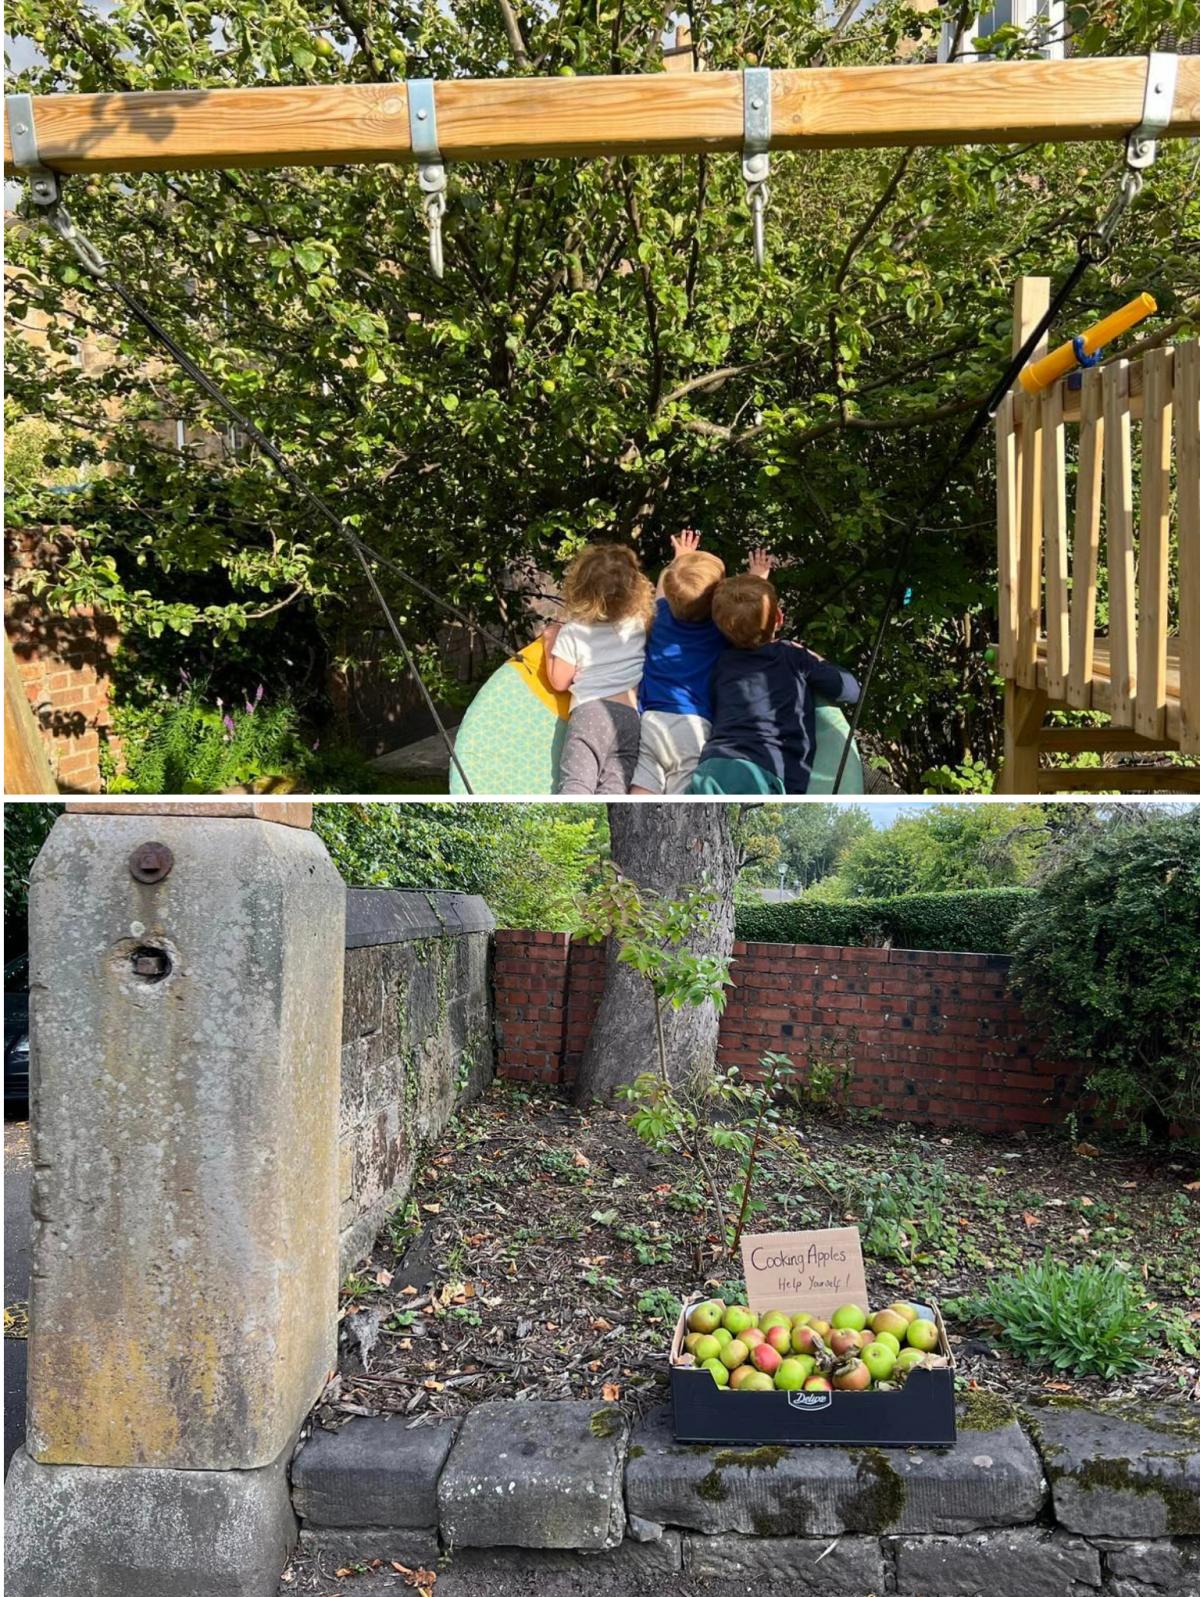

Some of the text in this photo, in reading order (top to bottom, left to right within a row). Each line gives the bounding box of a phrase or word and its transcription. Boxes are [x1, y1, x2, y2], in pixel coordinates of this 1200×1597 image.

[751, 1243, 846, 1274] Cooking Apples
[778, 1277, 802, 1292] Help
[793, 1392, 827, 1405] Deluxe
